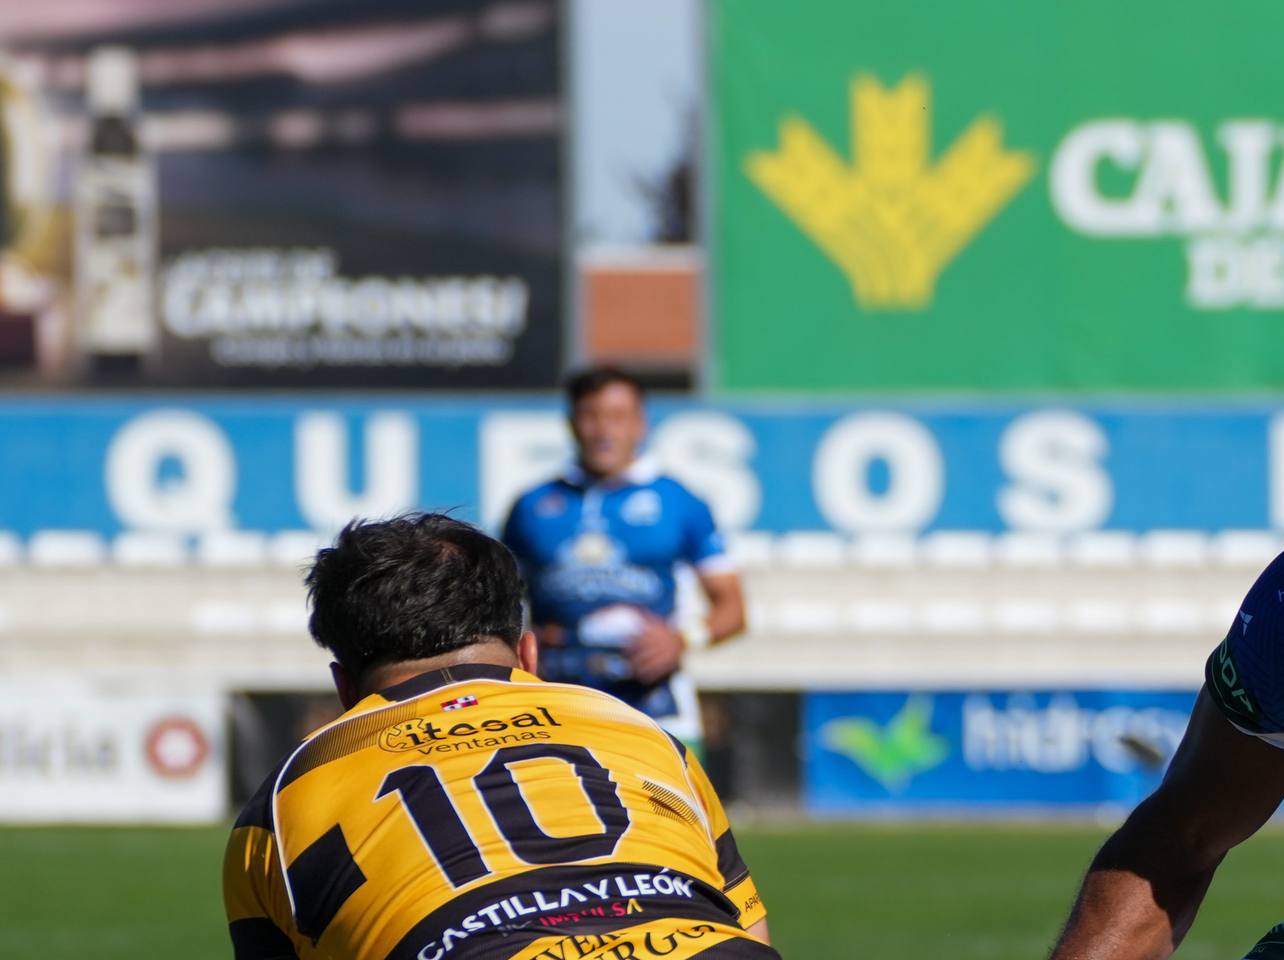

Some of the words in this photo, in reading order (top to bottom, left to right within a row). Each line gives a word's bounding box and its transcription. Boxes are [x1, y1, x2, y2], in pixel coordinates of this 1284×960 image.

[417, 730, 551, 756] ventanas
[374, 744, 630, 890] 10
[583, 878, 609, 900] Y
[614, 866, 694, 899] LEÓN
